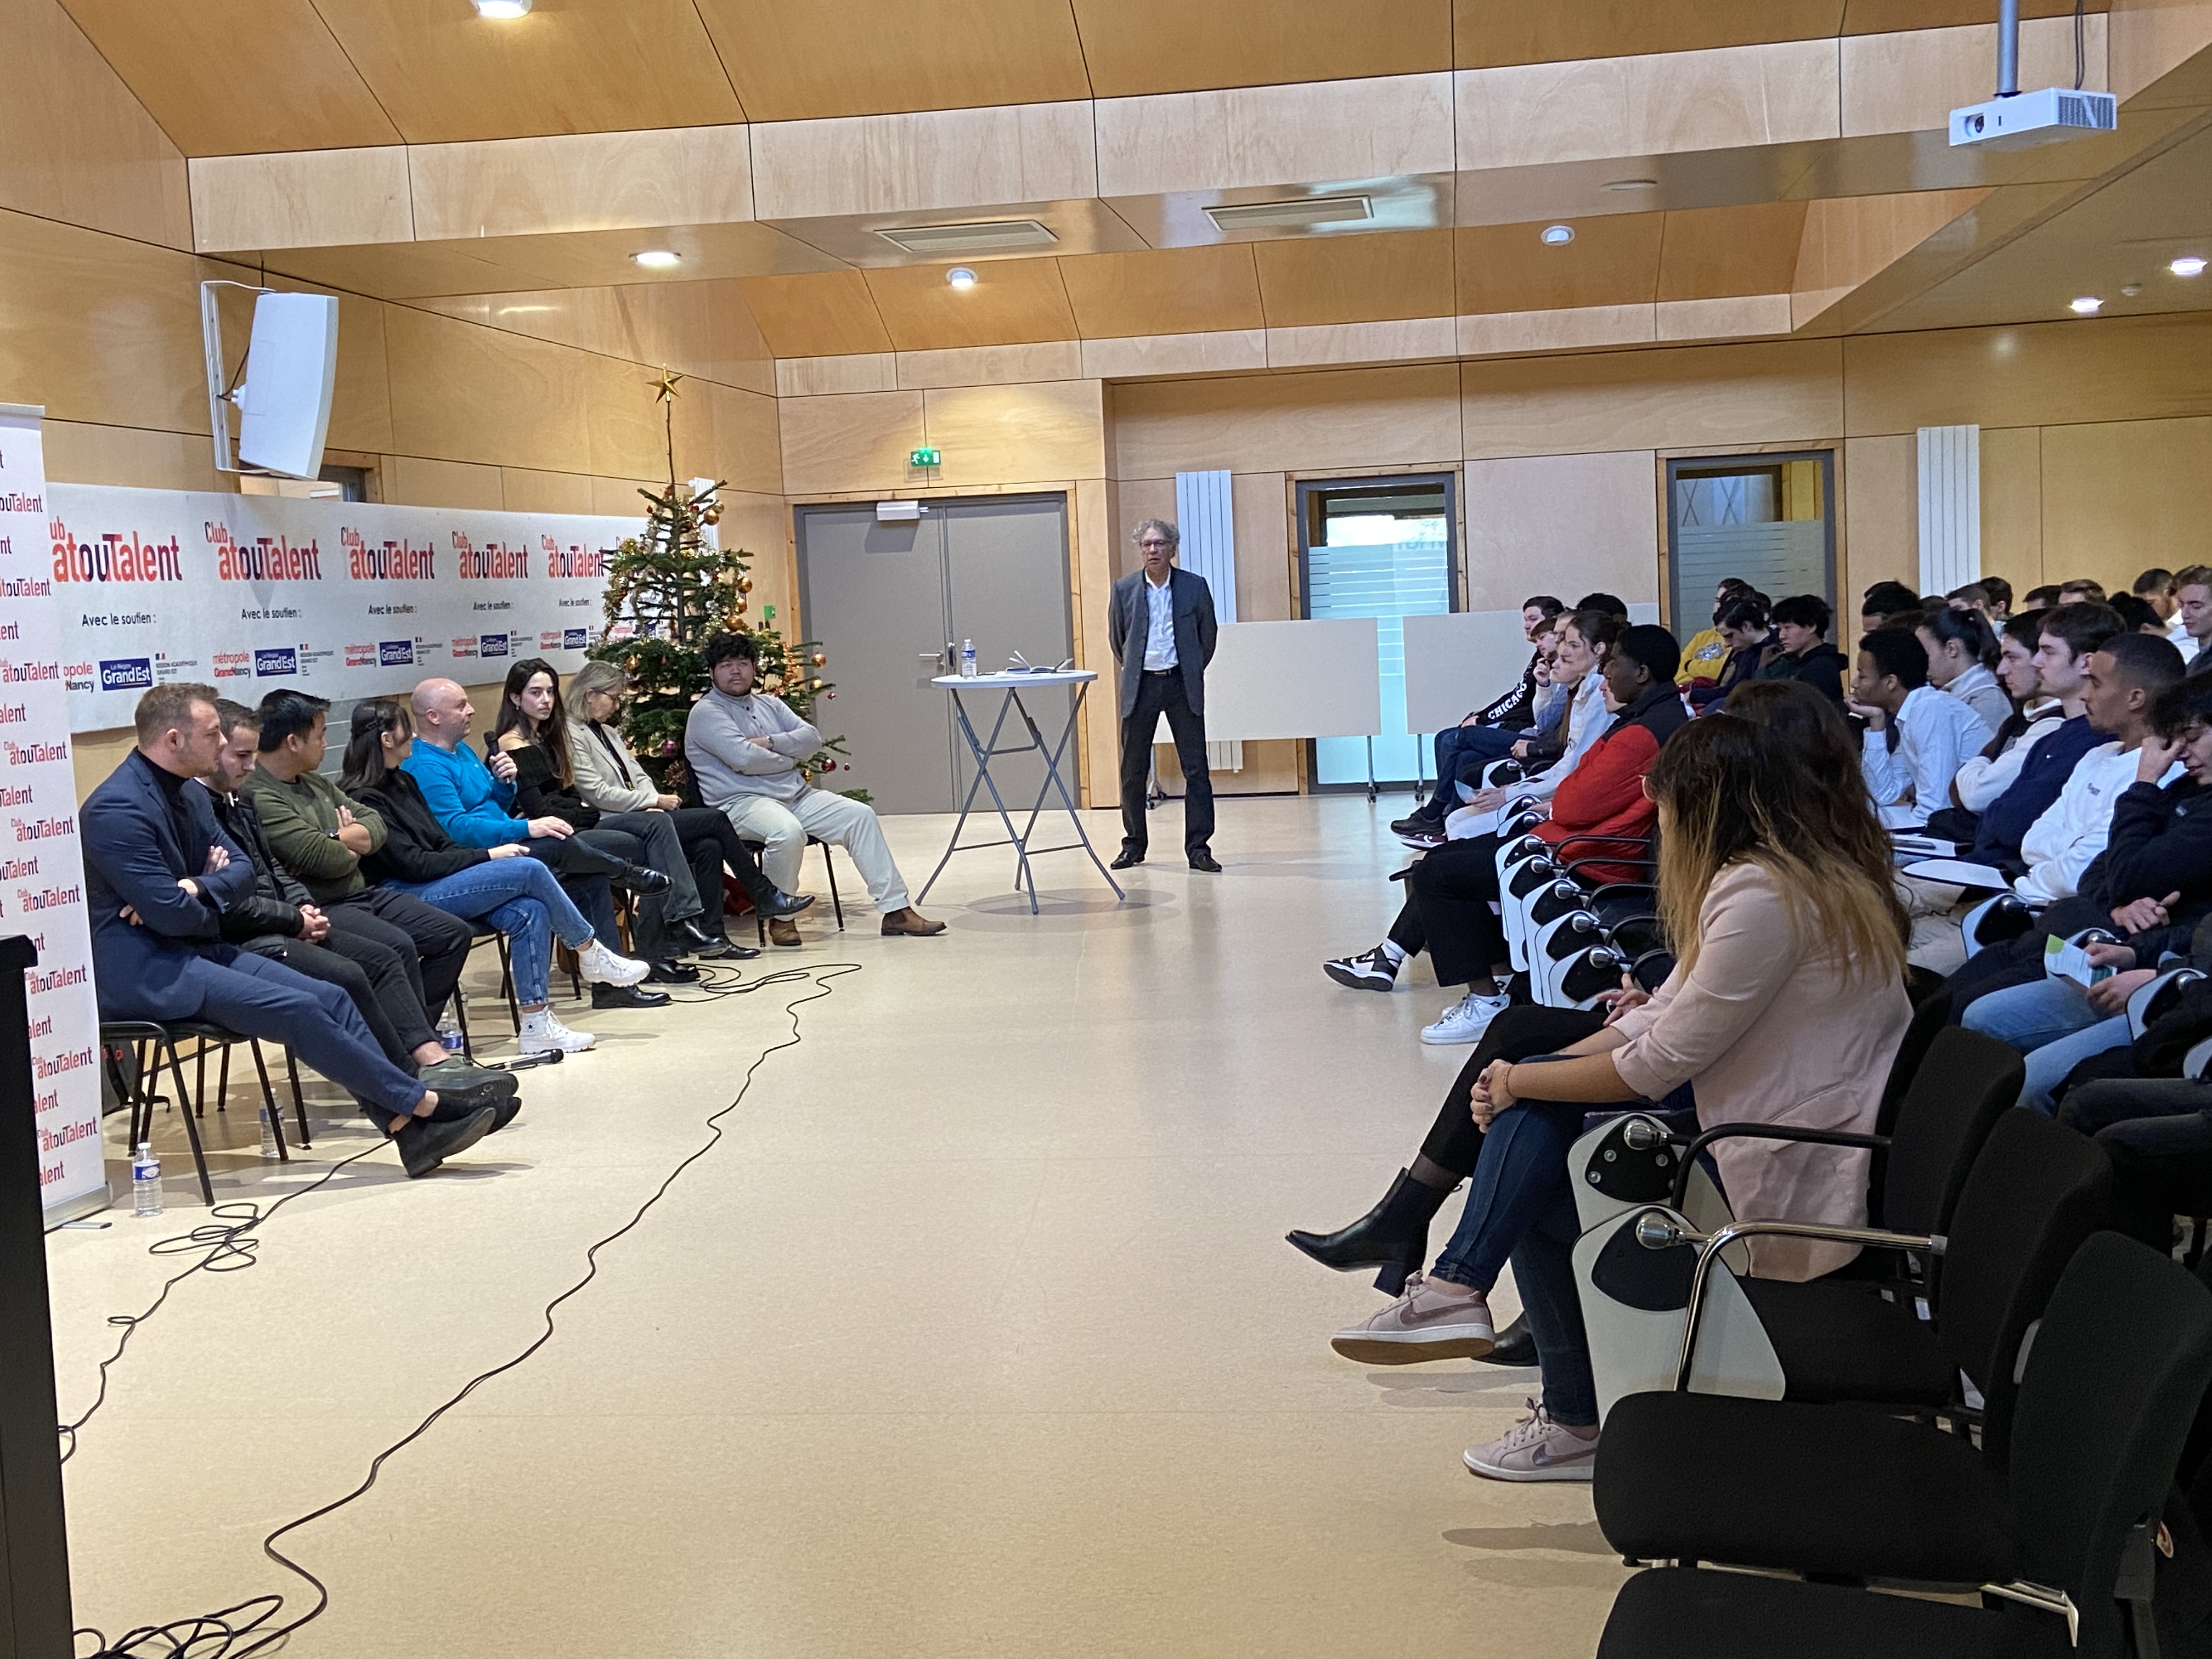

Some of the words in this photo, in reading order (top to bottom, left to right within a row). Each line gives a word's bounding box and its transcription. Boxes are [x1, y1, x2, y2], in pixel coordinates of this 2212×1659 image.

[205, 521, 228, 544] Club
[341, 526, 360, 546] Club
[52, 531, 183, 583] atouTalent
[218, 535, 322, 580] atouTalent
[349, 538, 435, 580] atouTalent
[459, 541, 528, 579] atouTalent
[549, 543, 604, 578] atouTalent
[0, 577, 51, 597] touTalent
[81, 614, 108, 627] Avec
[110, 613, 119, 625] le
[121, 612, 151, 625] soutien
[241, 608, 261, 619] Avec
[263, 608, 270, 619] le
[368, 605, 385, 615] Avec
[2, 661, 59, 683] atouTalent
[1487, 682, 1527, 720] CHICAGO
[10, 741, 67, 765] atouTalent
[16, 816, 74, 842] atouTalent
[22, 884, 80, 913] atouTalent
[30, 964, 87, 995] atouTalent
[37, 1046, 93, 1080] atouTalent
[43, 1116, 97, 1152] atouTalent
